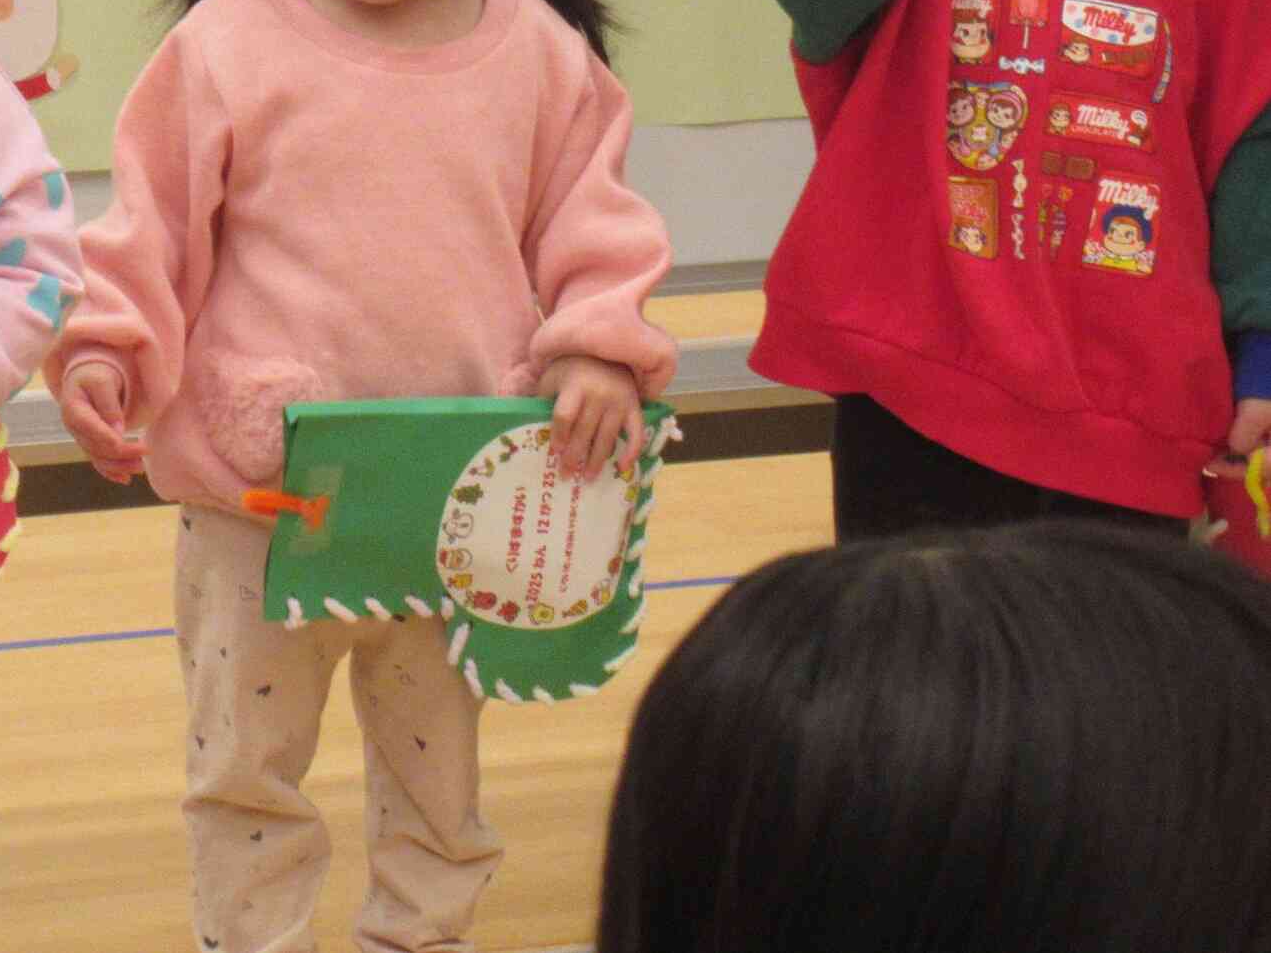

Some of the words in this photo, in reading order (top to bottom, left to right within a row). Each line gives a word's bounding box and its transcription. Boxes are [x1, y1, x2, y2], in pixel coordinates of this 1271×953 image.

[1082, 5, 1136, 43] Milky
[1076, 103, 1130, 140] Milky
[1098, 177, 1160, 220] Milky
